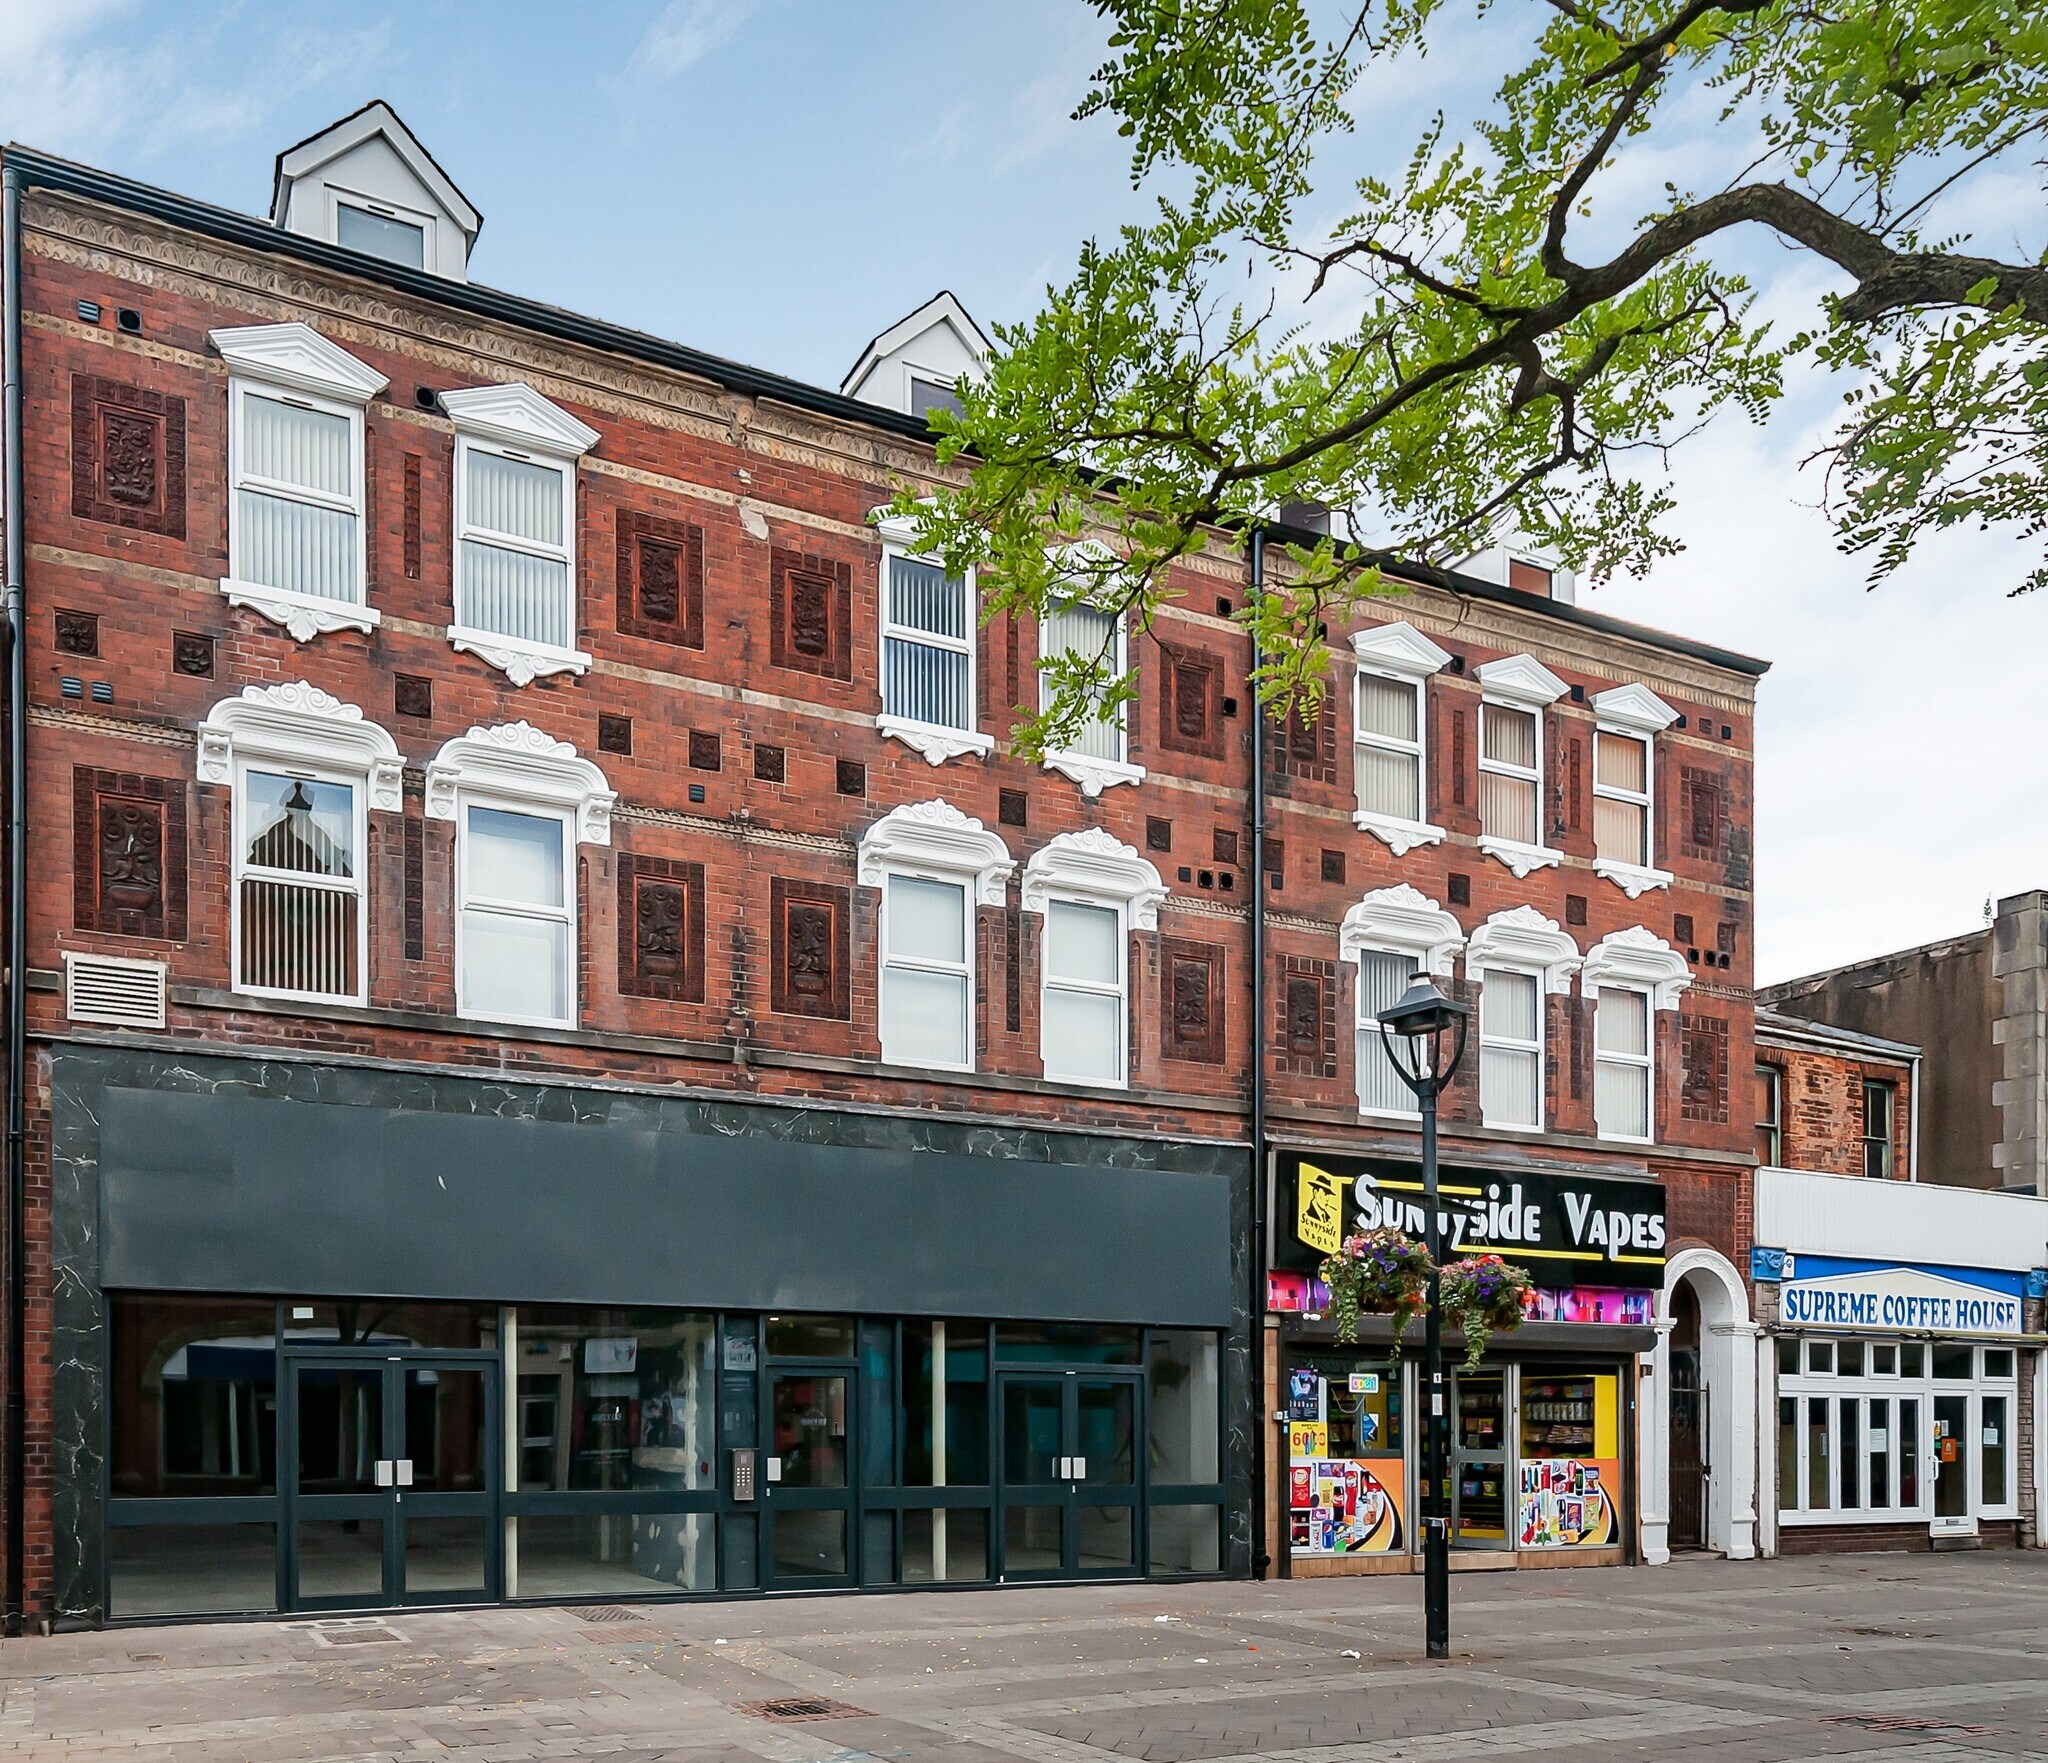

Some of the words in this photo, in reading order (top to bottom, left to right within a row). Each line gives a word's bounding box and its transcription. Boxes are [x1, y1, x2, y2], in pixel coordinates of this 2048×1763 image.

[1786, 1288, 1878, 1324] SUPREME
[1883, 1295, 1951, 1328] COFFEE
[1956, 1299, 2016, 1330] HOUSE
[1293, 1432, 1326, 1447] 600
